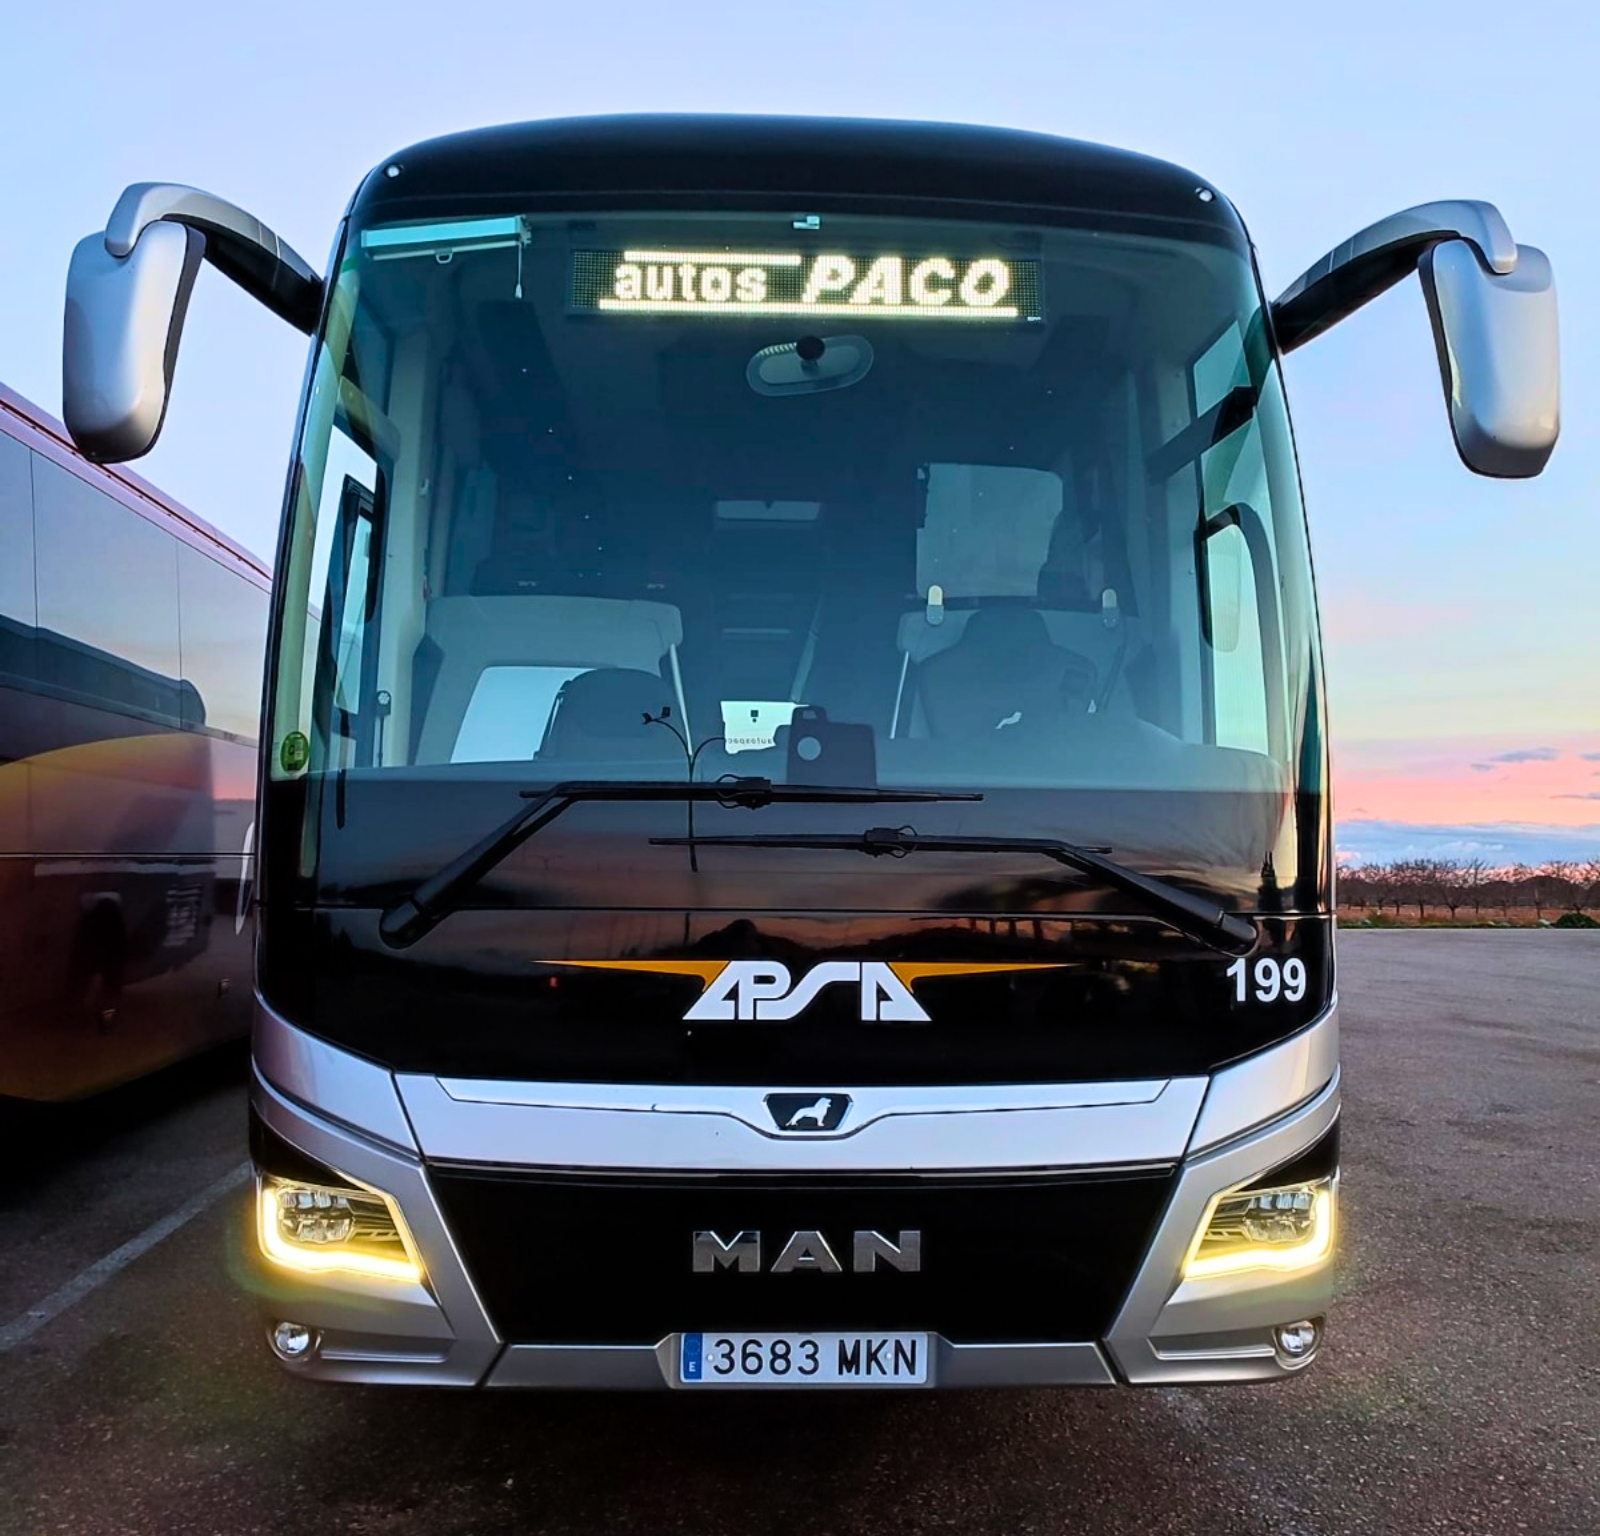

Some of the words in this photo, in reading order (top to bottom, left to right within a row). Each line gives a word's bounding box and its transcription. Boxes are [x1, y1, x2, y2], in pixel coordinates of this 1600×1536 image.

[615, 262, 768, 302] autos
[802, 254, 1011, 307] PACO
[682, 960, 933, 1021] APSA
[1226, 957, 1307, 1002] 199
[692, 1230, 921, 1273] MAN
[689, 1361, 696, 1372] E
[712, 1339, 820, 1376] 3683
[837, 1339, 917, 1376] MKN
